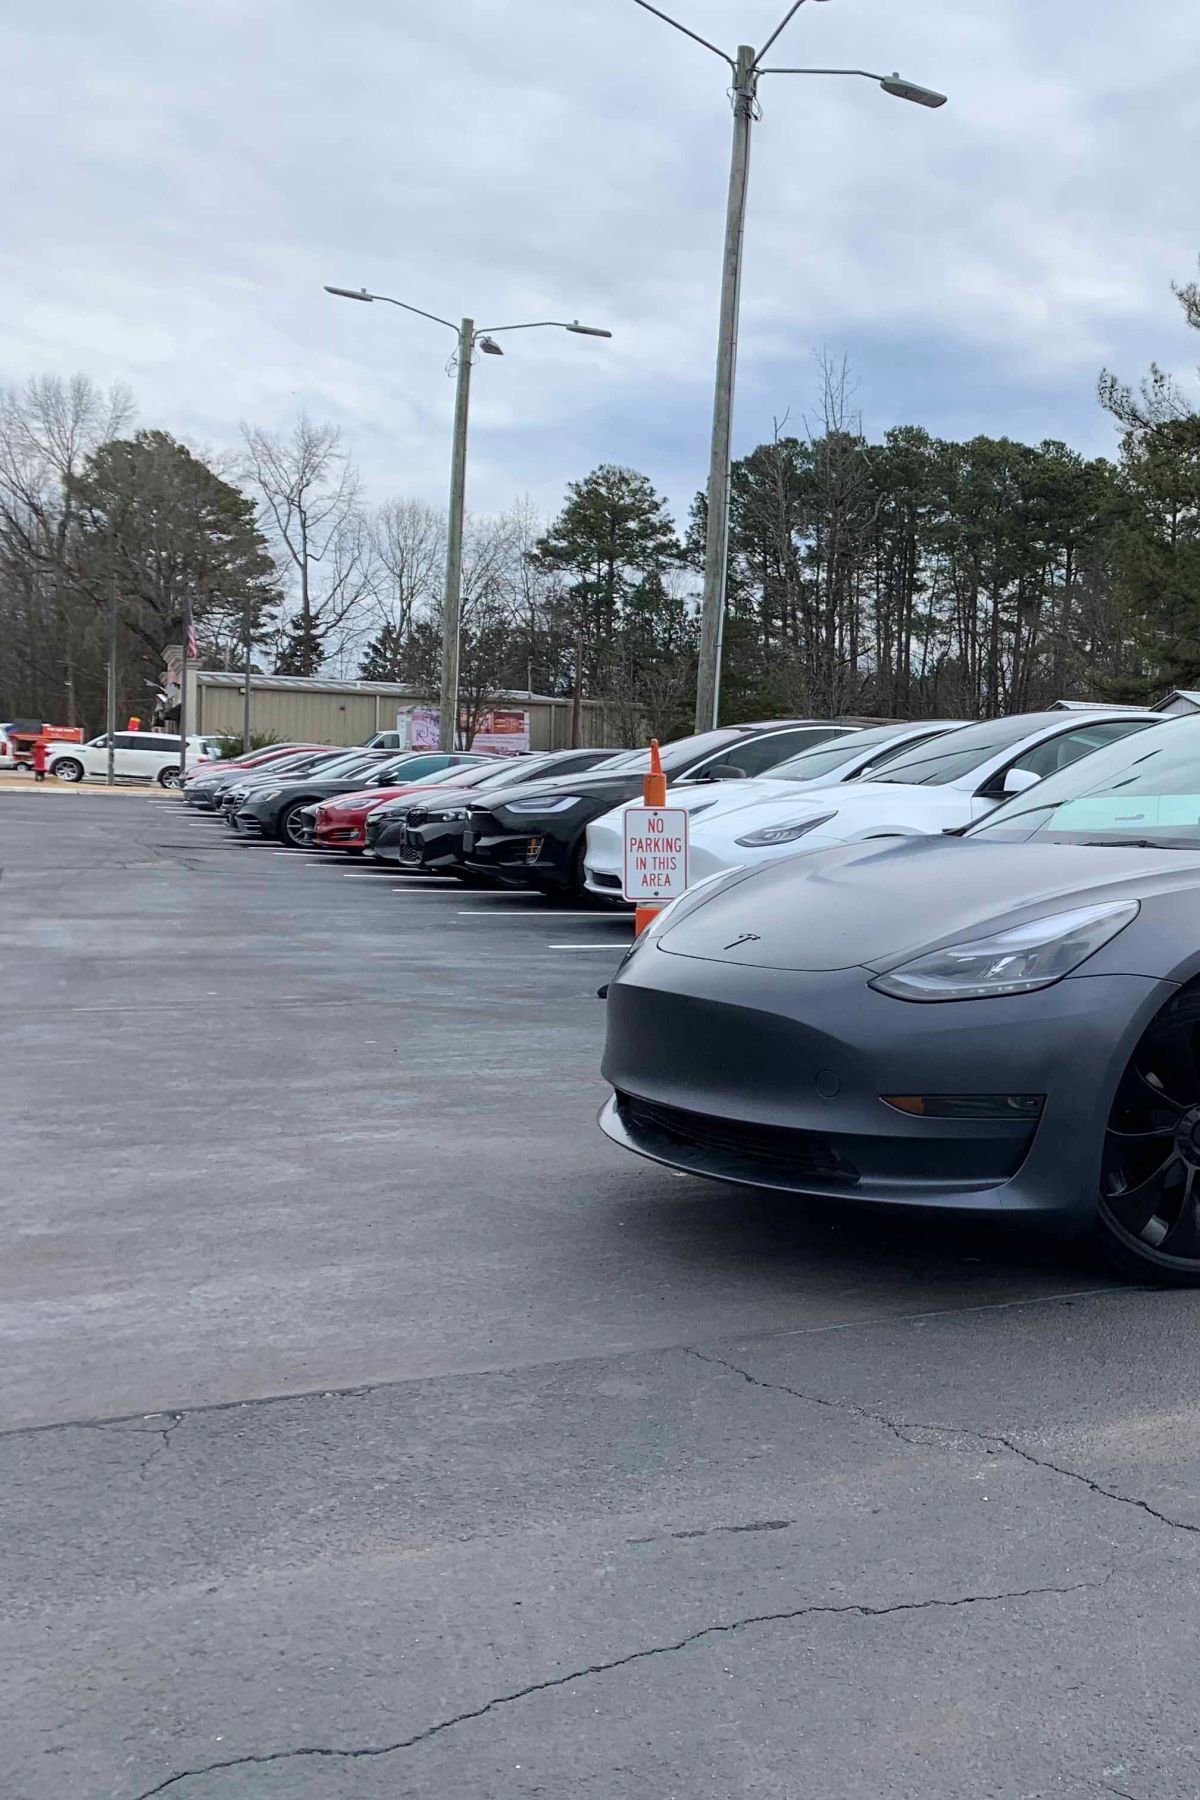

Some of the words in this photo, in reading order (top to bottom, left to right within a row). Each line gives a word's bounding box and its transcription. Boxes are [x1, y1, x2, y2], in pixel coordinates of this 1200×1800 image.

[648, 818, 664, 833] NO
[630, 838, 682, 853] PARKING
[636, 857, 646, 870] IN
[652, 857, 677, 870] THIS
[641, 873, 671, 887] AREA
